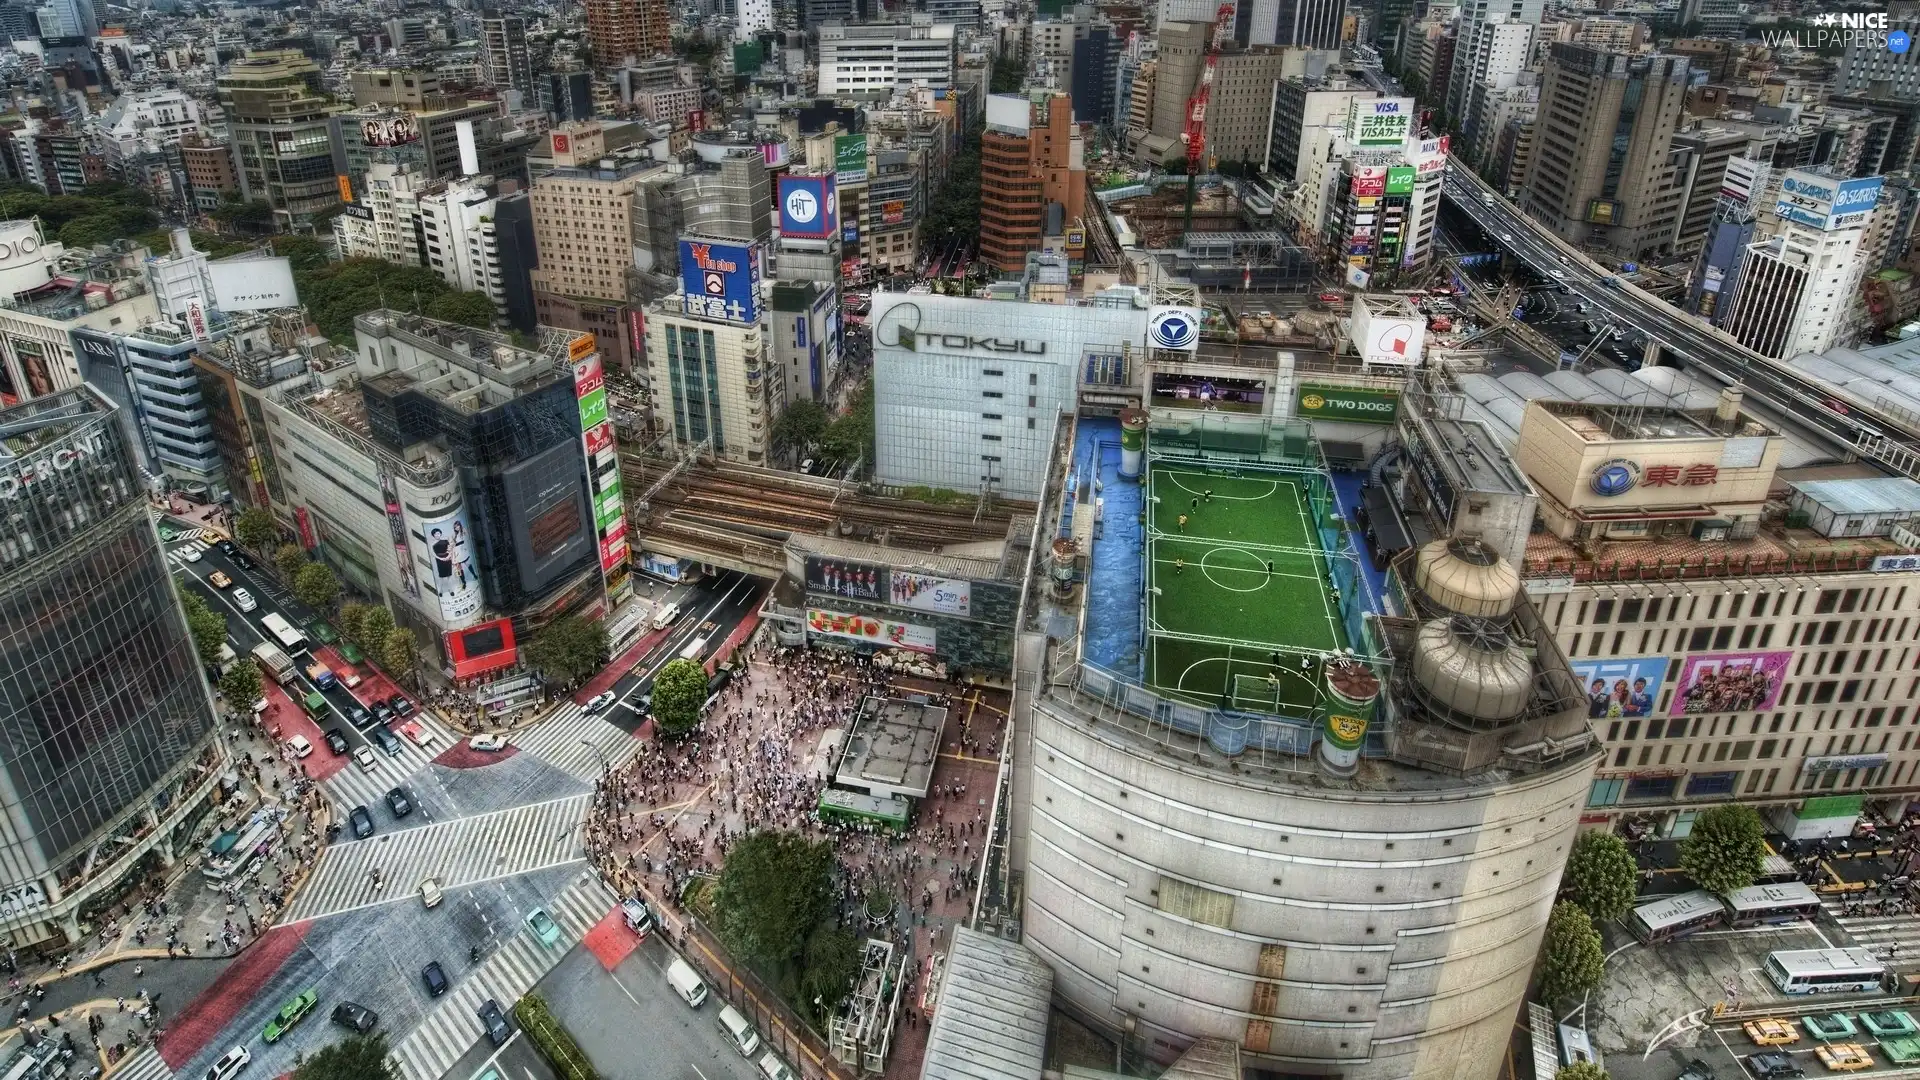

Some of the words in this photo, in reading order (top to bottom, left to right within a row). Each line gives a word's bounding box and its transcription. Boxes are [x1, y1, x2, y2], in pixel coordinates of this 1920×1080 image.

[1375, 102, 1399, 113] VISA
[1362, 115, 1408, 127] 三井住友
[1360, 127, 1407, 138] VISAカード
[1360, 179, 1382, 188] アコム
[1389, 174, 1412, 185] レイク
[686, 293, 747, 322] 武富士
[76, 338, 116, 358] ZARA
[916, 332, 1046, 355] TOKYU
[579, 376, 603, 395] アコム
[581, 398, 605, 420] レイク
[1325, 399, 1356, 410] TWO
[1357, 401, 1394, 412] DOGS
[588, 436, 612, 454] アイフル
[1641, 463, 1719, 488] 東急
[807, 579, 831, 593] Smap
[934, 589, 943, 602] 5
